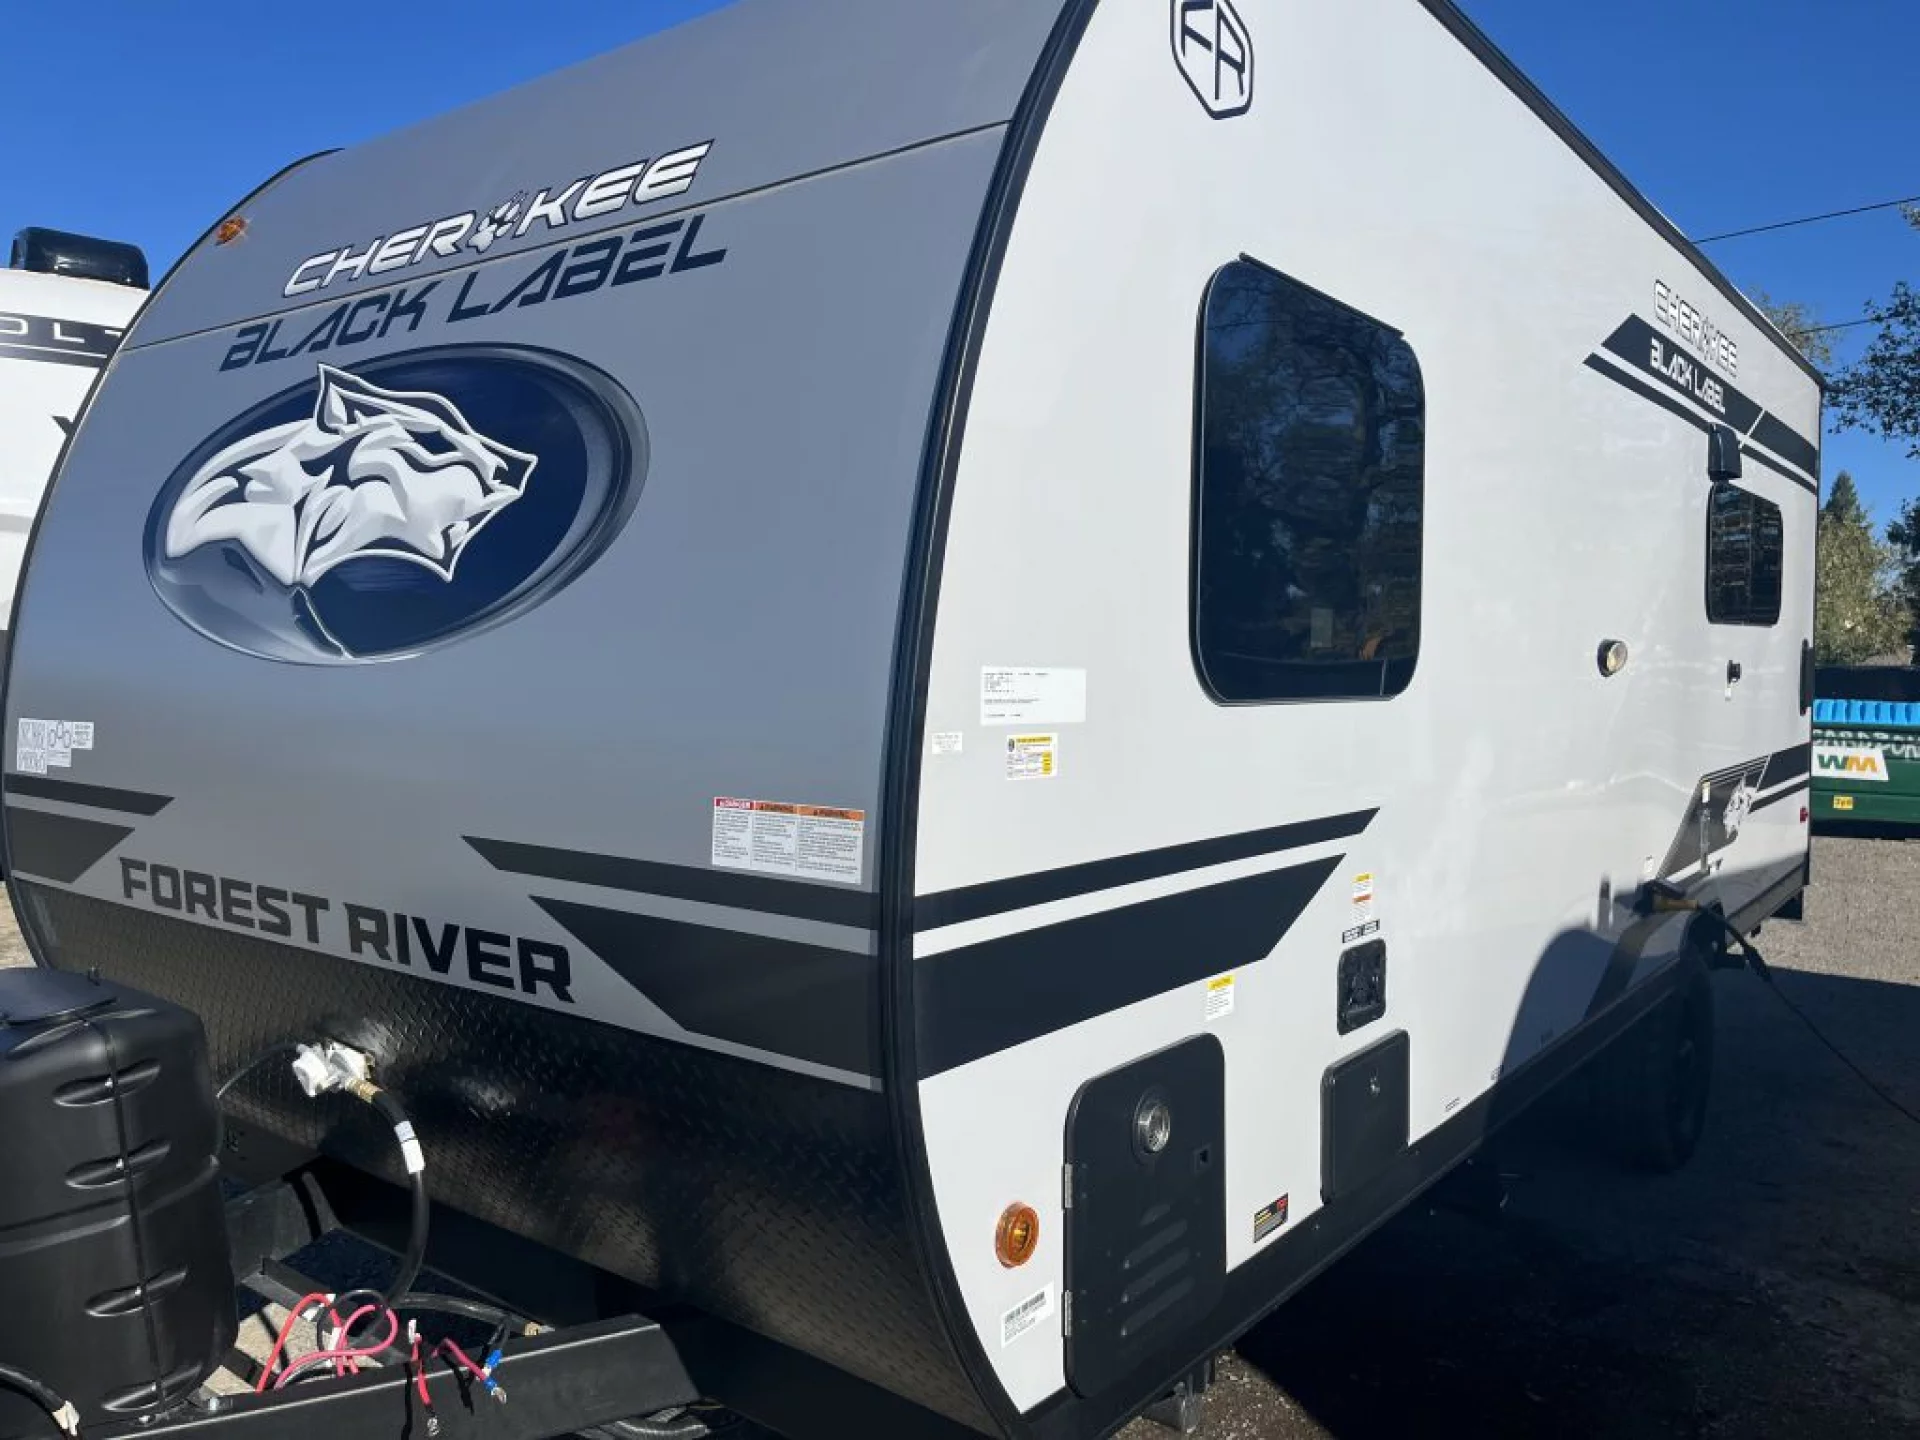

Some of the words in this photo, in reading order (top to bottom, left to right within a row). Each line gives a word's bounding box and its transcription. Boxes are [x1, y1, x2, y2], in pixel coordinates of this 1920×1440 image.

[218, 279, 444, 372] BLACK
[445, 213, 729, 323] LABEL
[282, 138, 716, 298] CHEROKEE
[1650, 336, 1693, 391] BLACK
[1695, 367, 1726, 415] LABEL
[1817, 755, 1878, 772] WM
[119, 855, 331, 944] FOREST
[343, 901, 576, 1004] RIVER
